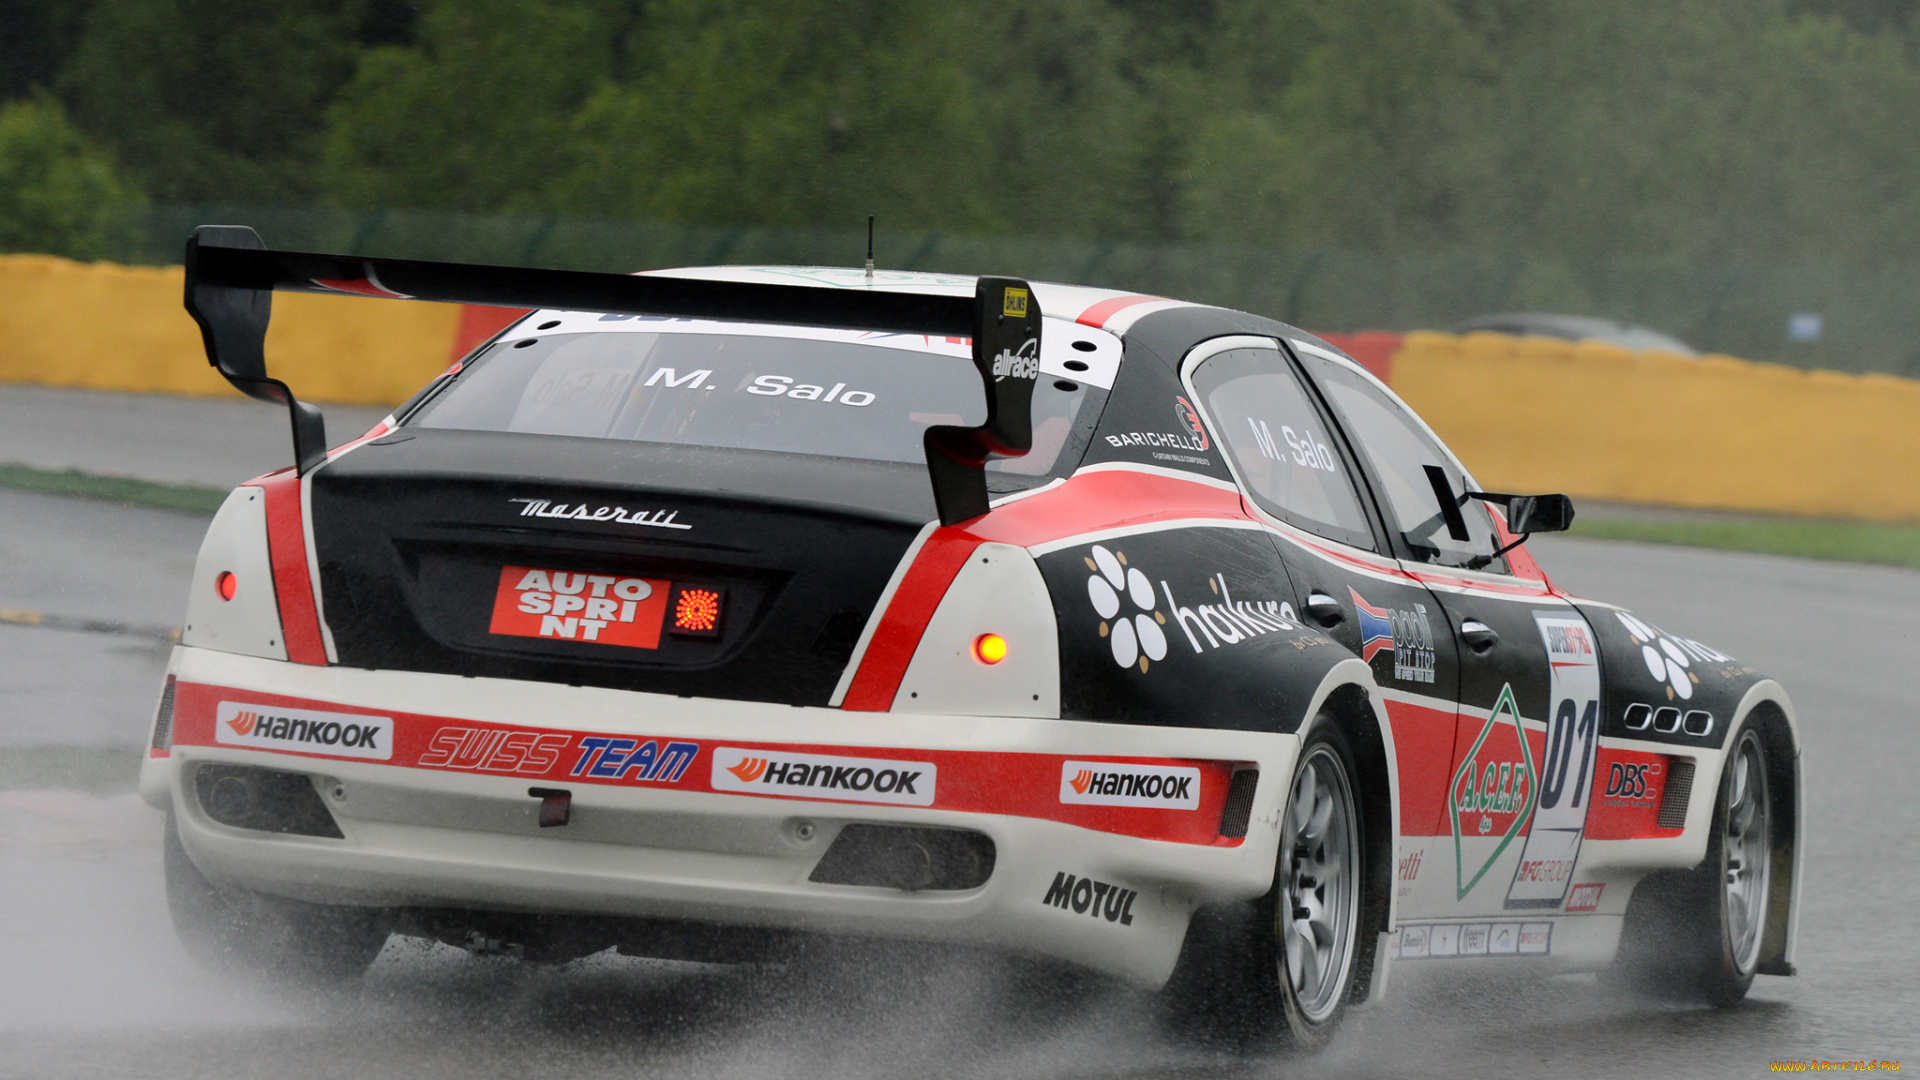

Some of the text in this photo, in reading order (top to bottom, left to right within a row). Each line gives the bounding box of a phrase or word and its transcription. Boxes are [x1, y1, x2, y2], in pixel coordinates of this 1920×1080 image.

[992, 348, 1039, 380] allrace
[643, 366, 876, 408] M. Salo
[1105, 432, 1205, 452] BARICHELLO
[1247, 417, 1336, 473] M. Salo
[508, 498, 693, 530] Maserati
[515, 569, 653, 601] AUTO
[517, 591, 638, 623] SPRI
[1160, 573, 1321, 654] haikura
[539, 615, 607, 641] NT
[1398, 649, 1436, 670] PIT STOP
[418, 726, 700, 782] SWISS TEAM
[1539, 698, 1598, 810] 01
[1458, 760, 1526, 814] A.C.E.F.
[1604, 761, 1650, 799] DBS
[1398, 848, 1424, 881] etti
[1043, 871, 1138, 926] MOTUL
